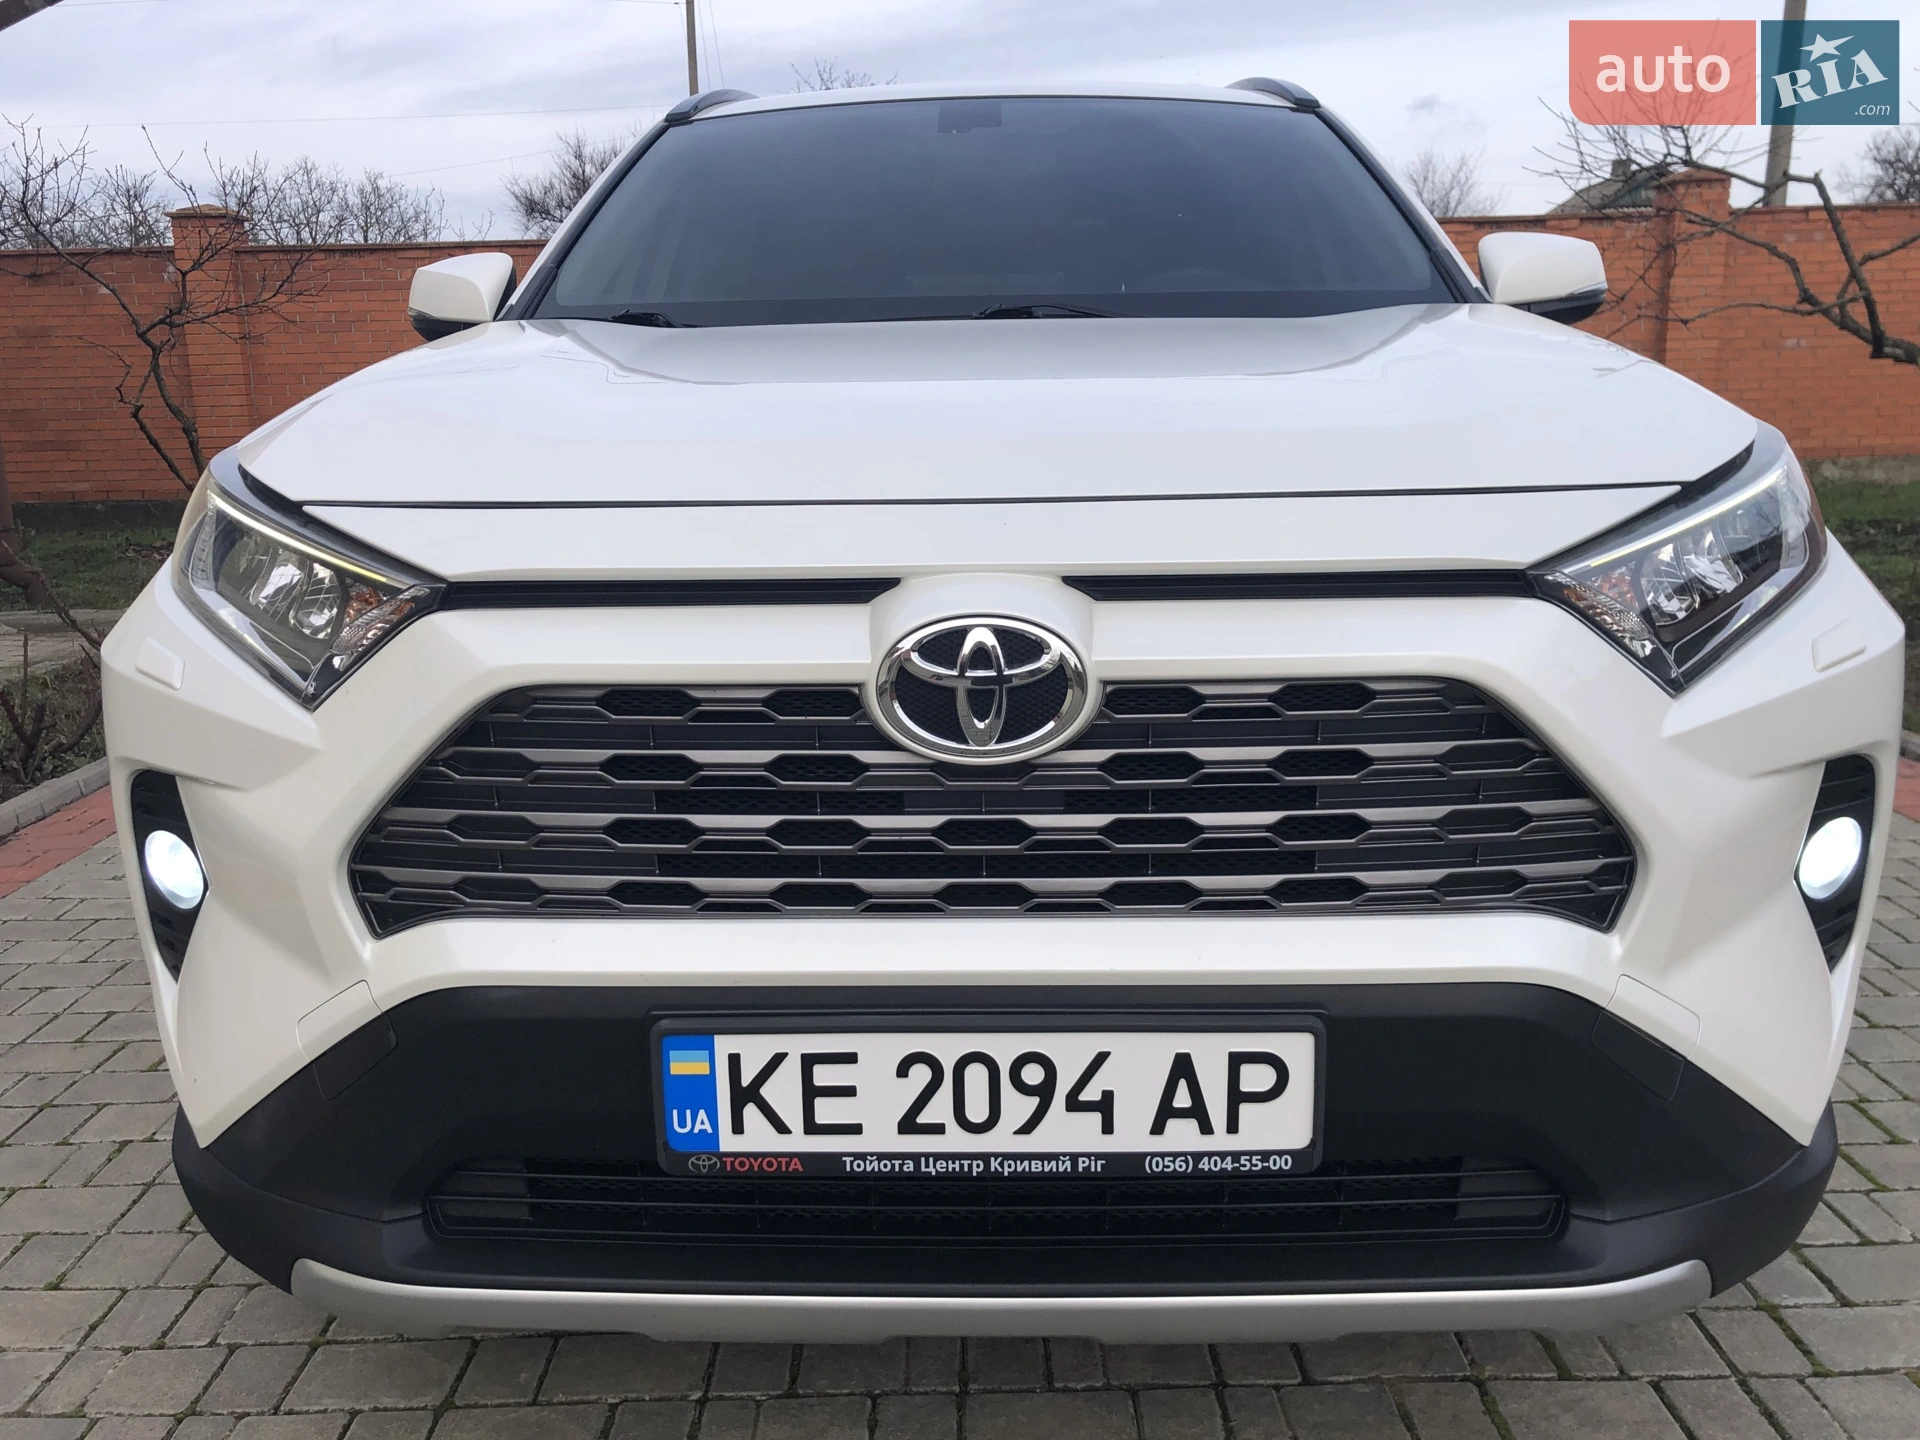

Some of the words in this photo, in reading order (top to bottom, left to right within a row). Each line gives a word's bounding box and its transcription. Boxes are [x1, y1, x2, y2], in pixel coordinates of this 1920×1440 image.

[727, 1050, 864, 1136] KE
[895, 1050, 1115, 1136] 2094
[1148, 1050, 1290, 1136] AP
[672, 1108, 713, 1134] UA
[723, 1157, 804, 1172] TOYOTA
[842, 1156, 914, 1173] Тойота
[920, 1156, 984, 1177] Центр
[990, 1156, 1072, 1177] Кривий
[1078, 1156, 1106, 1173] Ріг
[1144, 1155, 1194, 1174] (056)
[1198, 1154, 1292, 1172] 404-55-00
